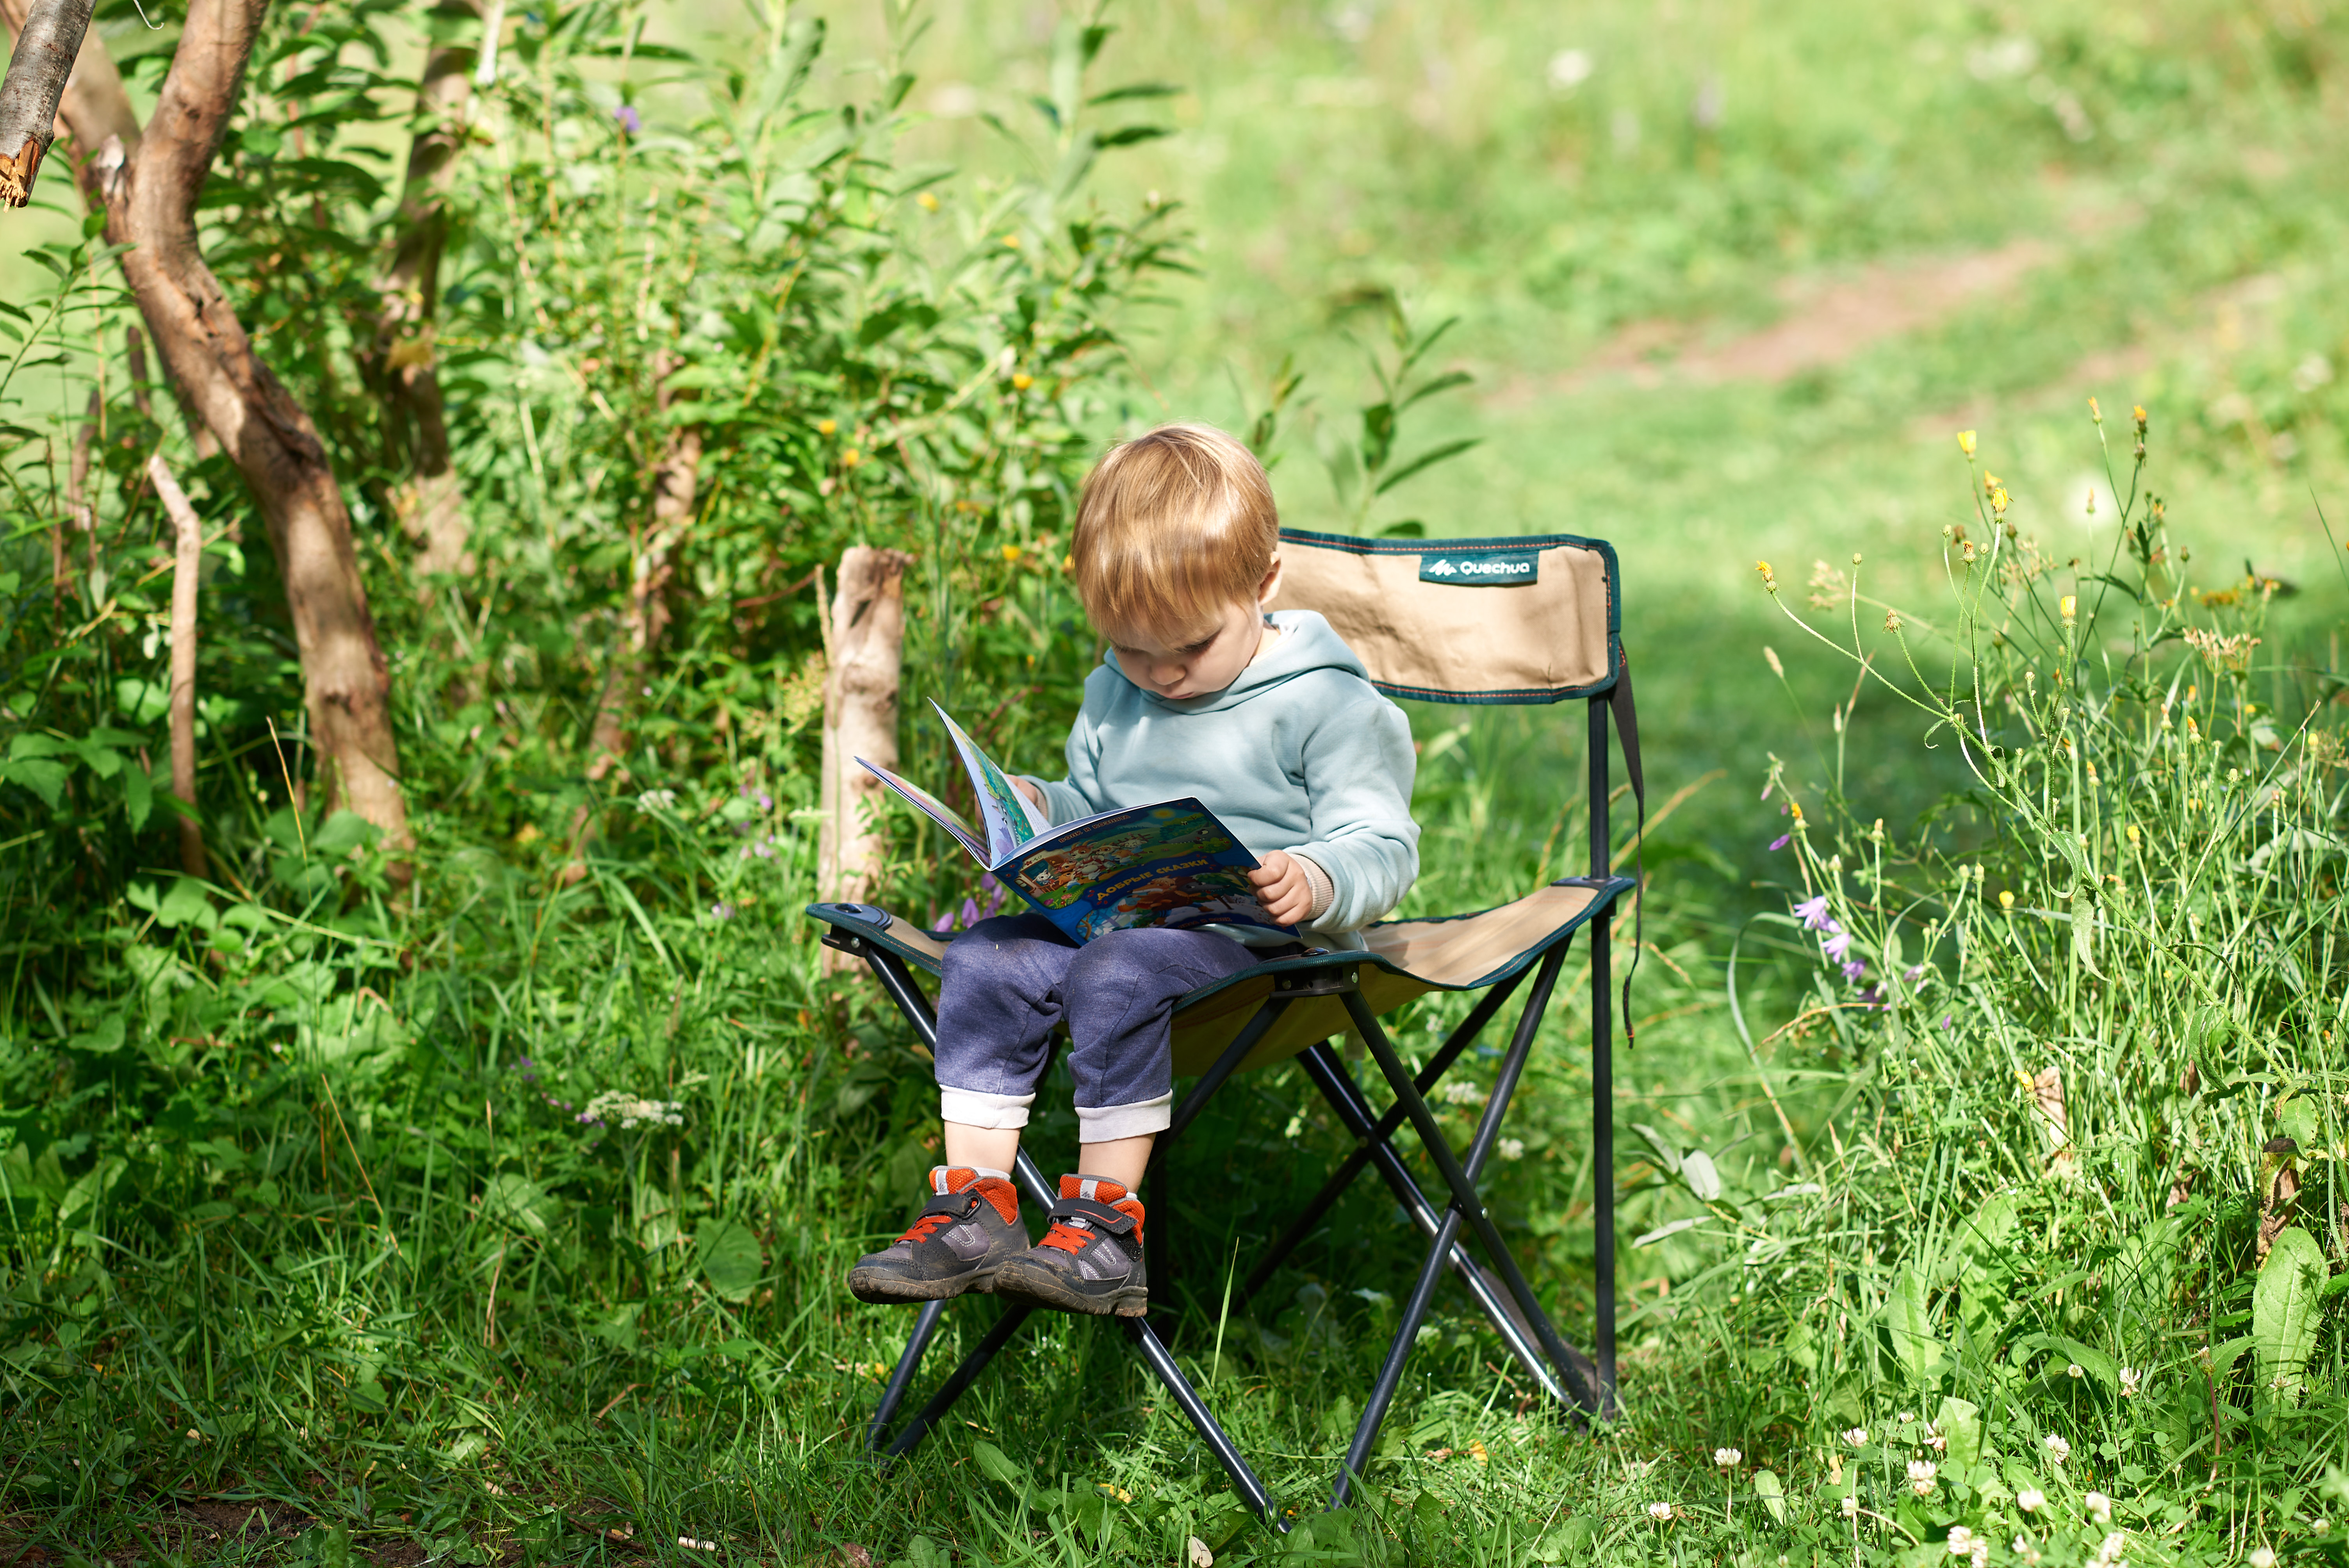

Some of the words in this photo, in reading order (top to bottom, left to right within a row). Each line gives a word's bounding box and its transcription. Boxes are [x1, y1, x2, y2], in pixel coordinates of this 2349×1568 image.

[1460, 561, 1530, 576] Quechua
[1059, 830, 1083, 843] ВОЛК
[1092, 815, 1131, 829] КОЗЛЯТА
[1097, 871, 1153, 900] ДОБРЫЕ
[1156, 859, 1209, 874] СКАЗКИ
